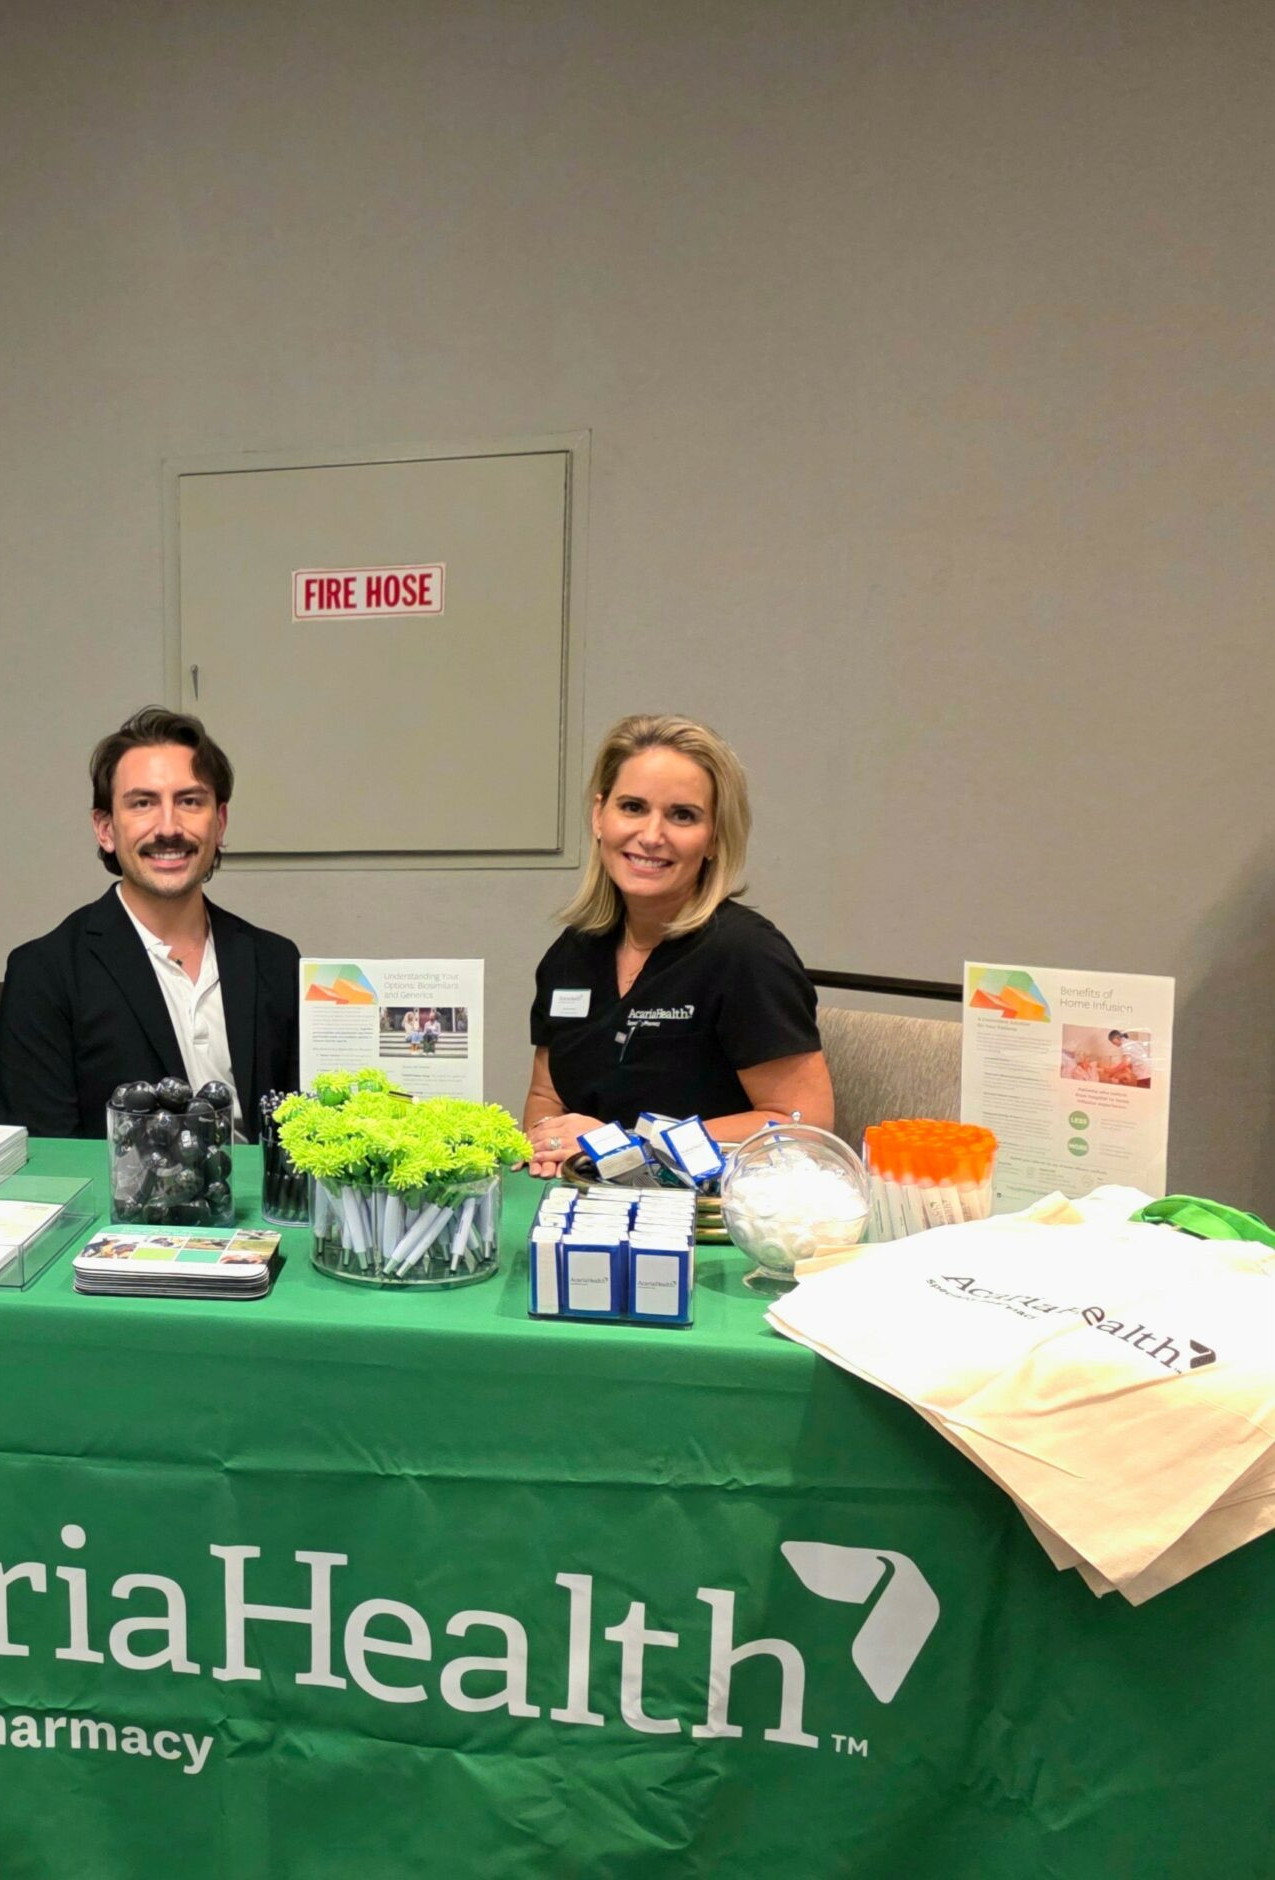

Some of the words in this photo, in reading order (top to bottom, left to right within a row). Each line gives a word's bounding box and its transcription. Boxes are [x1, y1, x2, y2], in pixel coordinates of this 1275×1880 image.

[305, 577, 357, 611] FIRE
[366, 573, 433, 608] HOSE
[383, 972, 441, 982] Understanding
[442, 972, 460, 981] Your
[384, 991, 399, 1000] and
[400, 991, 434, 1000] Generics
[1060, 985, 1101, 999] Benefits
[1102, 988, 1115, 1000] of
[1059, 997, 1091, 1010] Home
[1092, 999, 1134, 1014] Infusion
[628, 1008, 691, 1020] AcariaHealth
